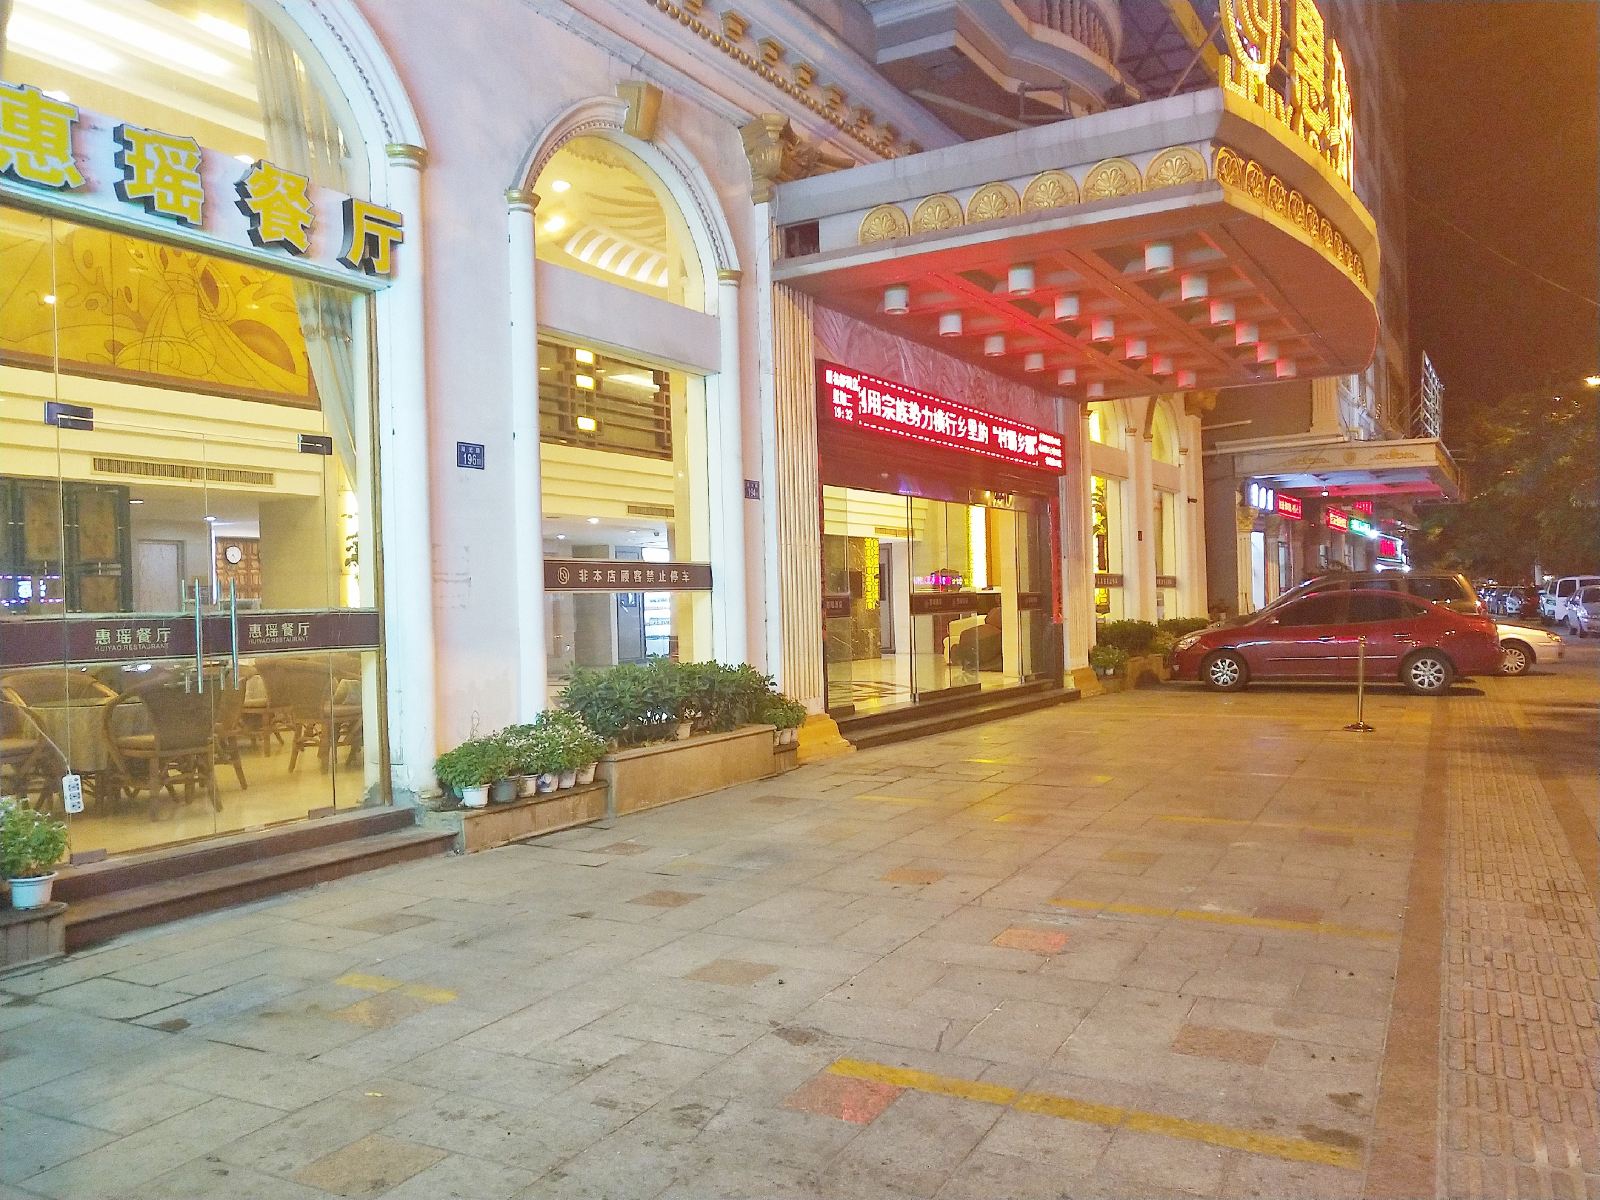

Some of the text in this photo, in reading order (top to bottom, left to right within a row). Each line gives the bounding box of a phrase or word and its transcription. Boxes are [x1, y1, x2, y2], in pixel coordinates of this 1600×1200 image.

[0, 83, 404, 276] 惠瑶餐厅
[578, 569, 691, 583] 非本店顾客禁止停车
[95, 628, 171, 645] 惠瑶餐厅
[248, 622, 310, 639] 惠瑶餐厅
